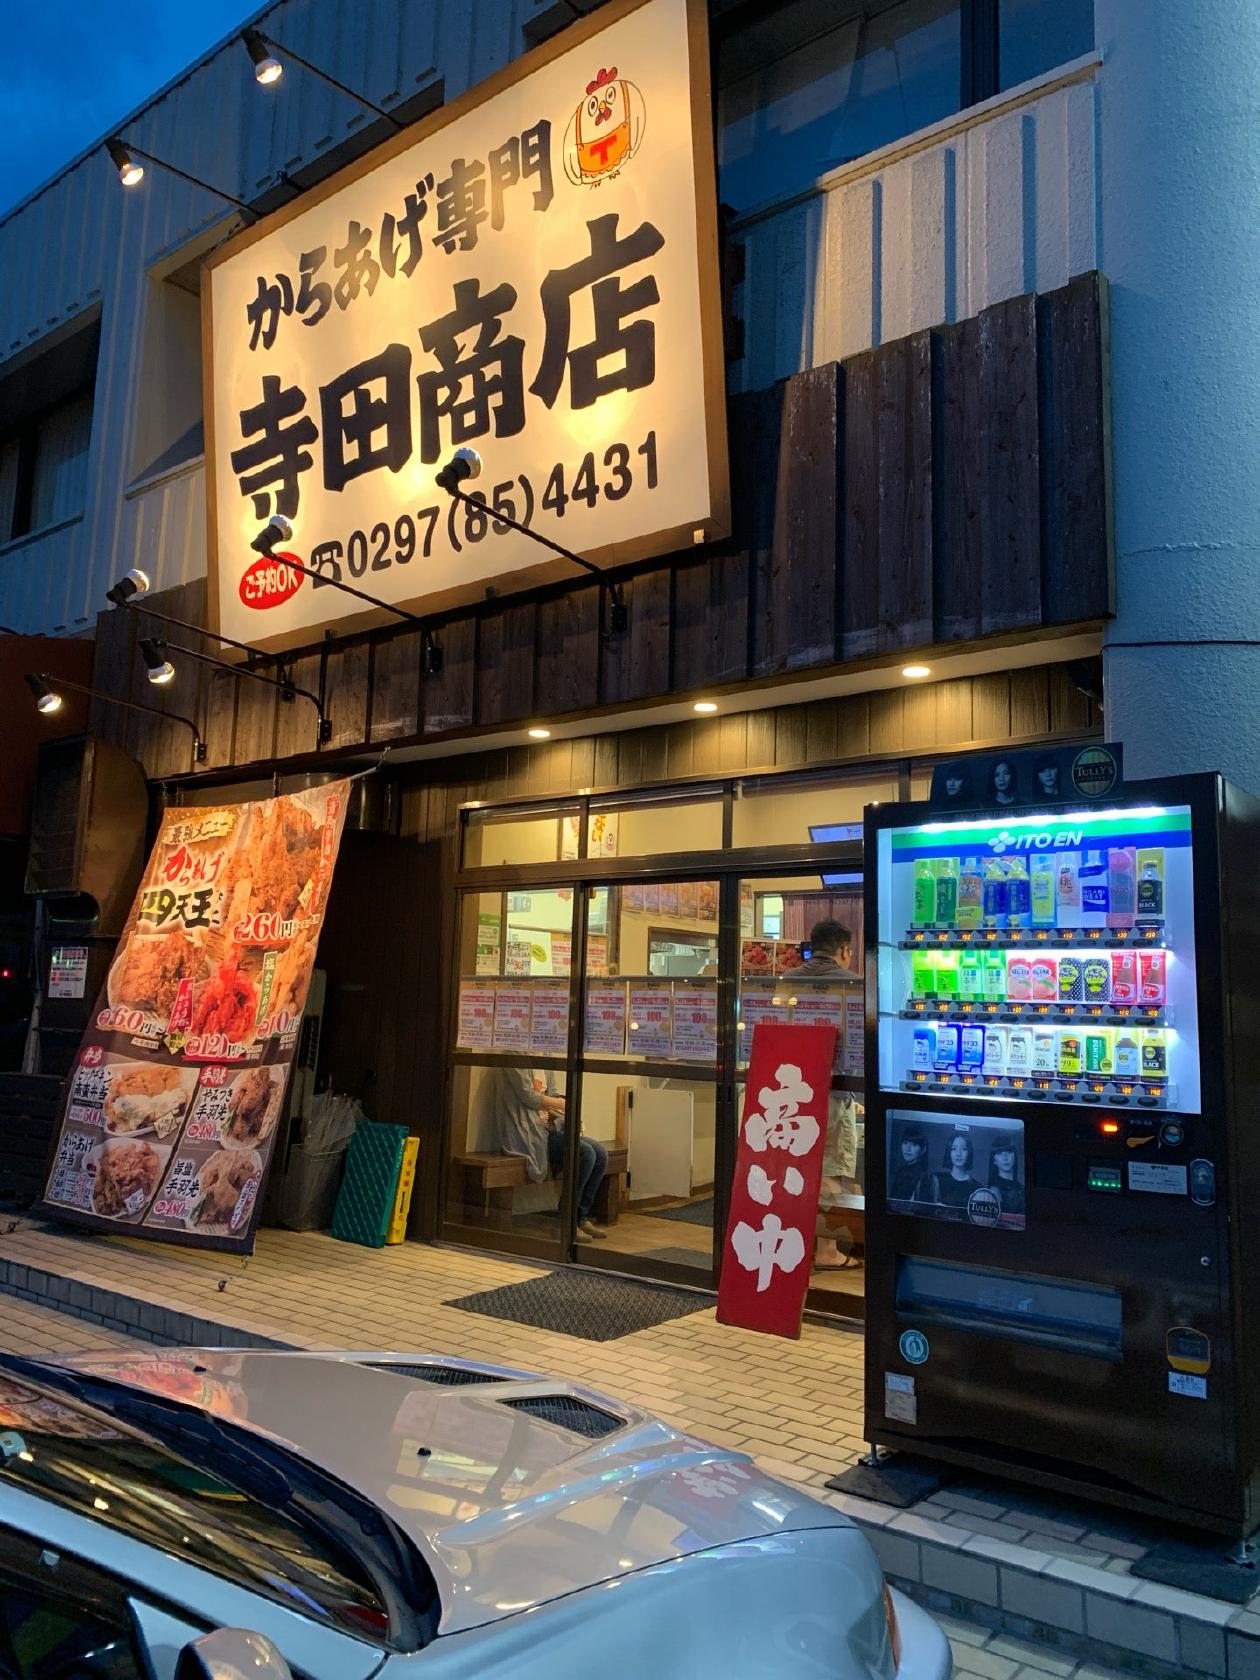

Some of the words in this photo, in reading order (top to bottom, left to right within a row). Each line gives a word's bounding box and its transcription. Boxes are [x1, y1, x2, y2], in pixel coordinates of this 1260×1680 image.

[246, 119, 554, 351] からあげ専門
[230, 212, 667, 523] 寺田商店
[347, 430, 658, 578] 0297(85)4431
[1075, 766, 1113, 778] TULLY'S
[1015, 833, 1052, 849] ITO
[1053, 831, 1083, 847] EN
[138, 888, 214, 928] 四天王
[203, 1088, 234, 1102] やみつき
[196, 1104, 227, 1120] 手羽先
[60, 1149, 74, 1166] 弁当
[731, 1063, 820, 1292] 商い中
[166, 1178, 199, 1198] 手羽先
